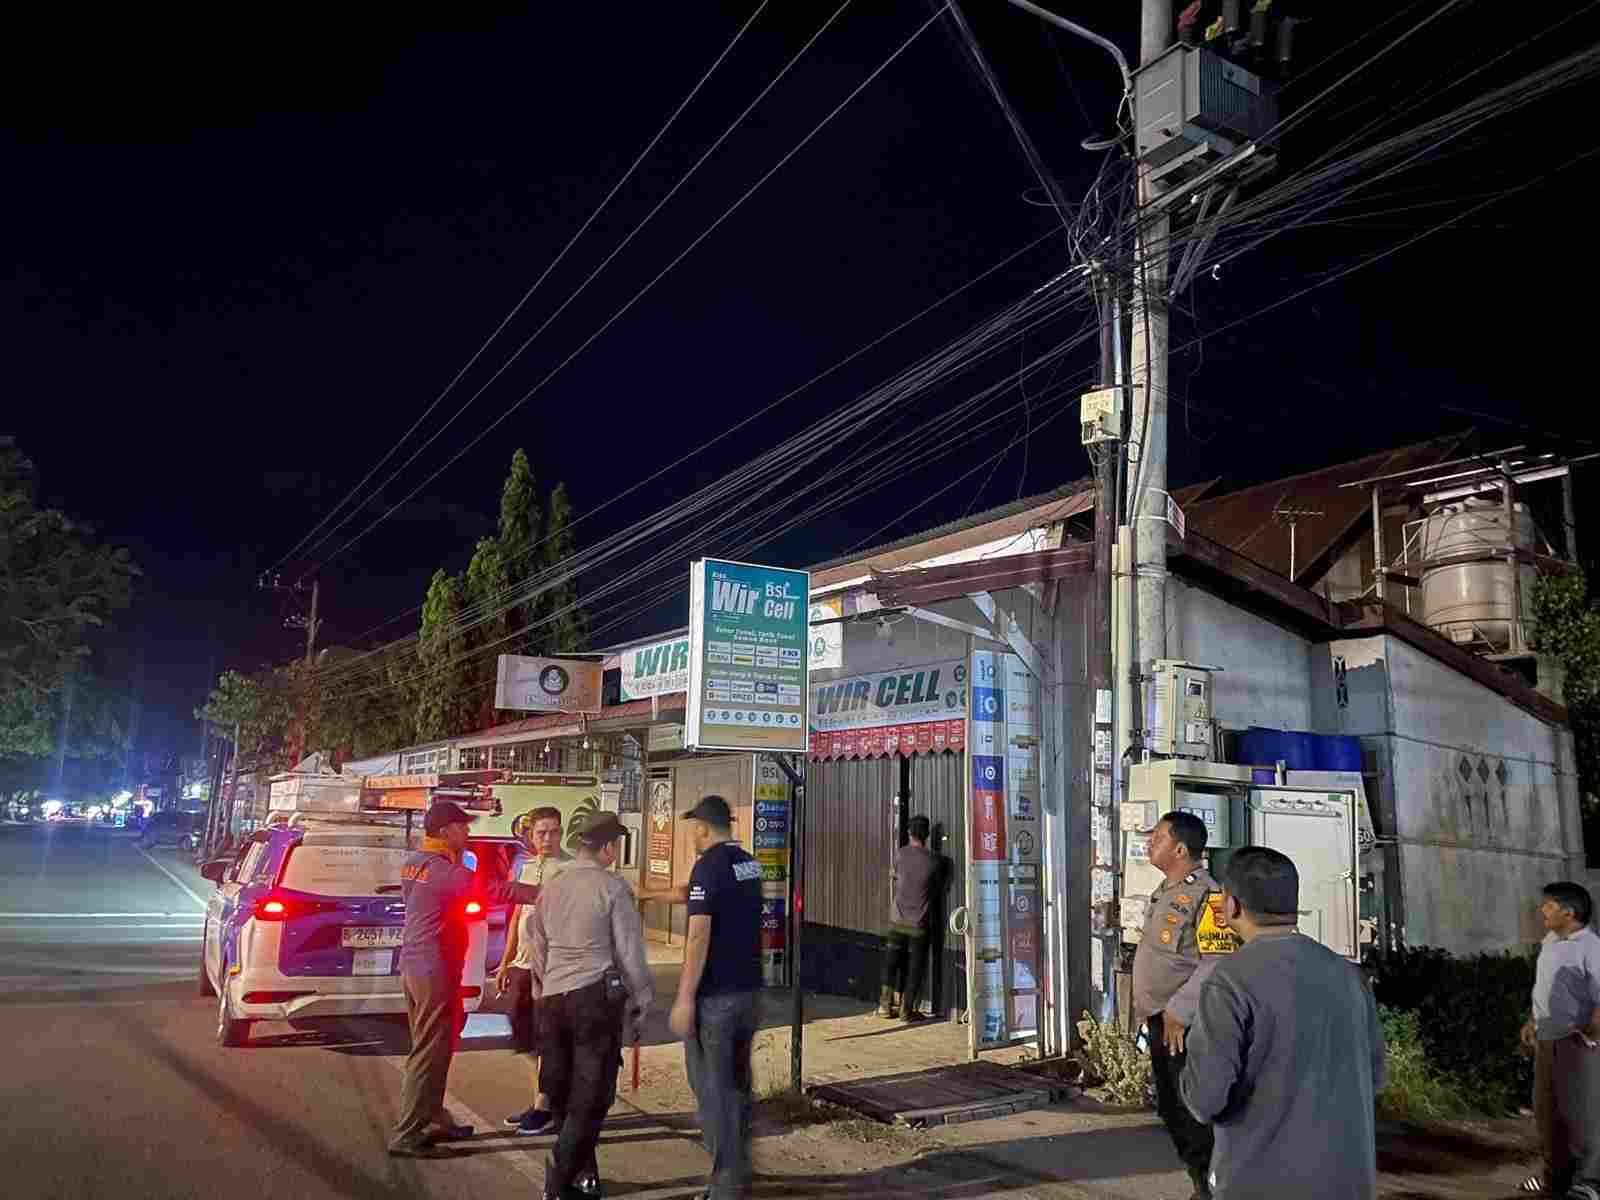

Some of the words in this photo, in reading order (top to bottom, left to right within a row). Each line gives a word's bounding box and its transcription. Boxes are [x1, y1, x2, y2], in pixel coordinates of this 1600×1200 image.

[711, 580, 760, 614] Wir
[764, 599, 795, 620] Cell
[633, 641, 689, 680] WIR
[815, 680, 870, 715] WIR
[875, 669, 941, 708] CELL
